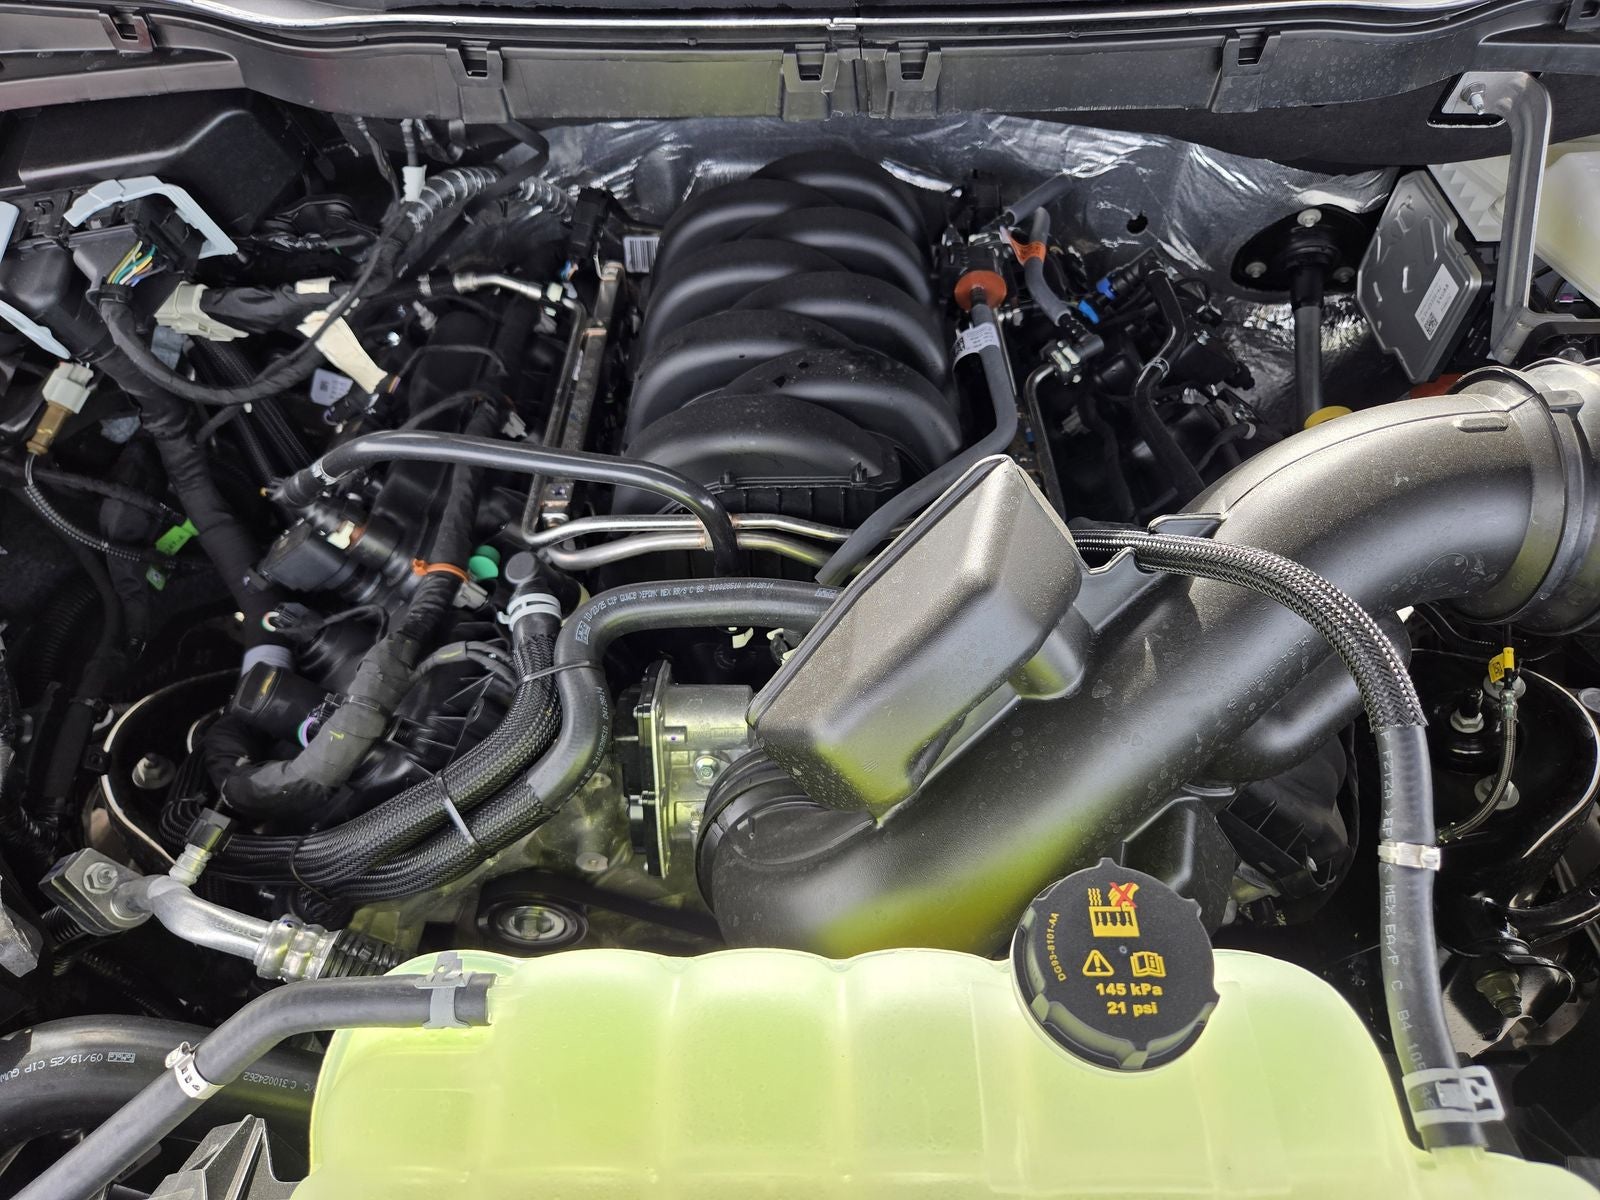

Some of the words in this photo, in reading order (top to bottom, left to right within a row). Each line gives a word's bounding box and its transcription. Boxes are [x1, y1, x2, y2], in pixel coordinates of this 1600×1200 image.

[1384, 884, 1396, 916] MEX
[1391, 979, 1403, 992] C
[1046, 912, 1067, 982] DG93-8101-AA
[1096, 983, 1126, 996] 145
[1131, 983, 1163, 996] kPa
[1107, 1002, 1127, 1015] 21
[1132, 1002, 1158, 1017] psi
[24, 1060, 45, 1073] CIP
[50, 1052, 104, 1067] 09/19/25
[243, 1071, 289, 1089] 310024262
[290, 1080, 297, 1089] C
